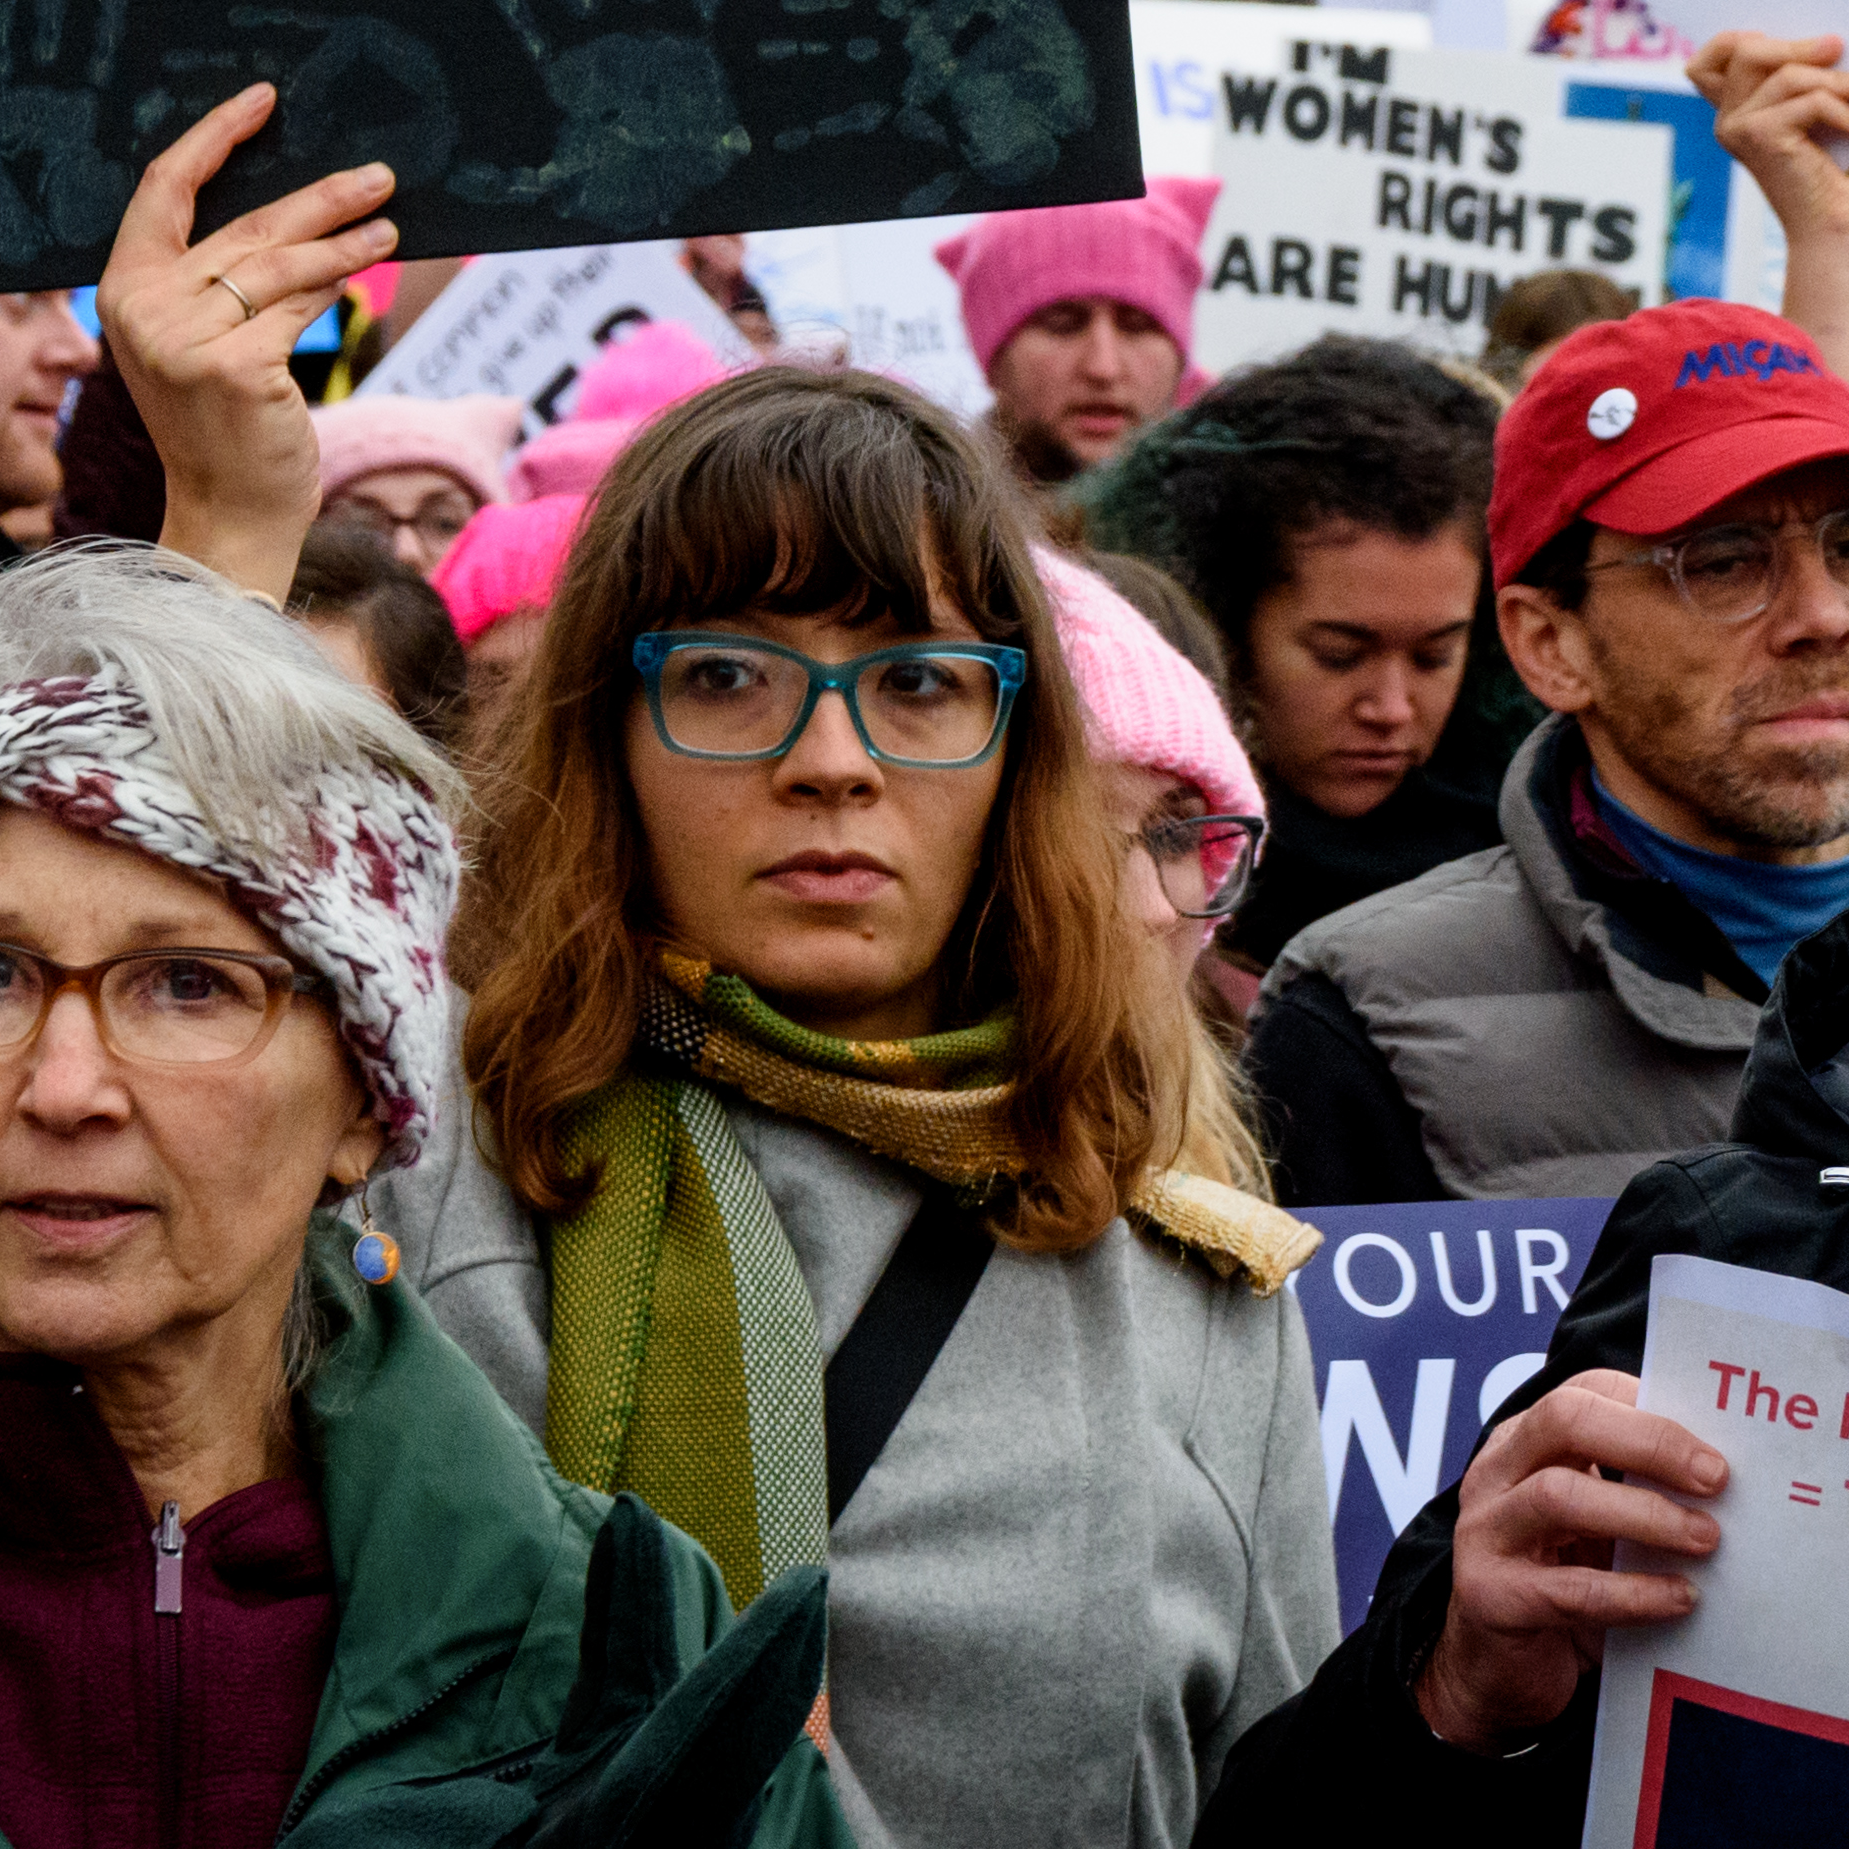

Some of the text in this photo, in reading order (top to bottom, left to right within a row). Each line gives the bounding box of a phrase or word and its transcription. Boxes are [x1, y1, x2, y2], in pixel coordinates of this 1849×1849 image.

[1288, 40, 1390, 83] I'M
[1222, 74, 1522, 173] WOMEN'S
[1380, 170, 1637, 262] RIGHTS
[1212, 234, 1361, 305] ARE
[1286, 1228, 1571, 1318] OUR
[1708, 1359, 1819, 1432] The
